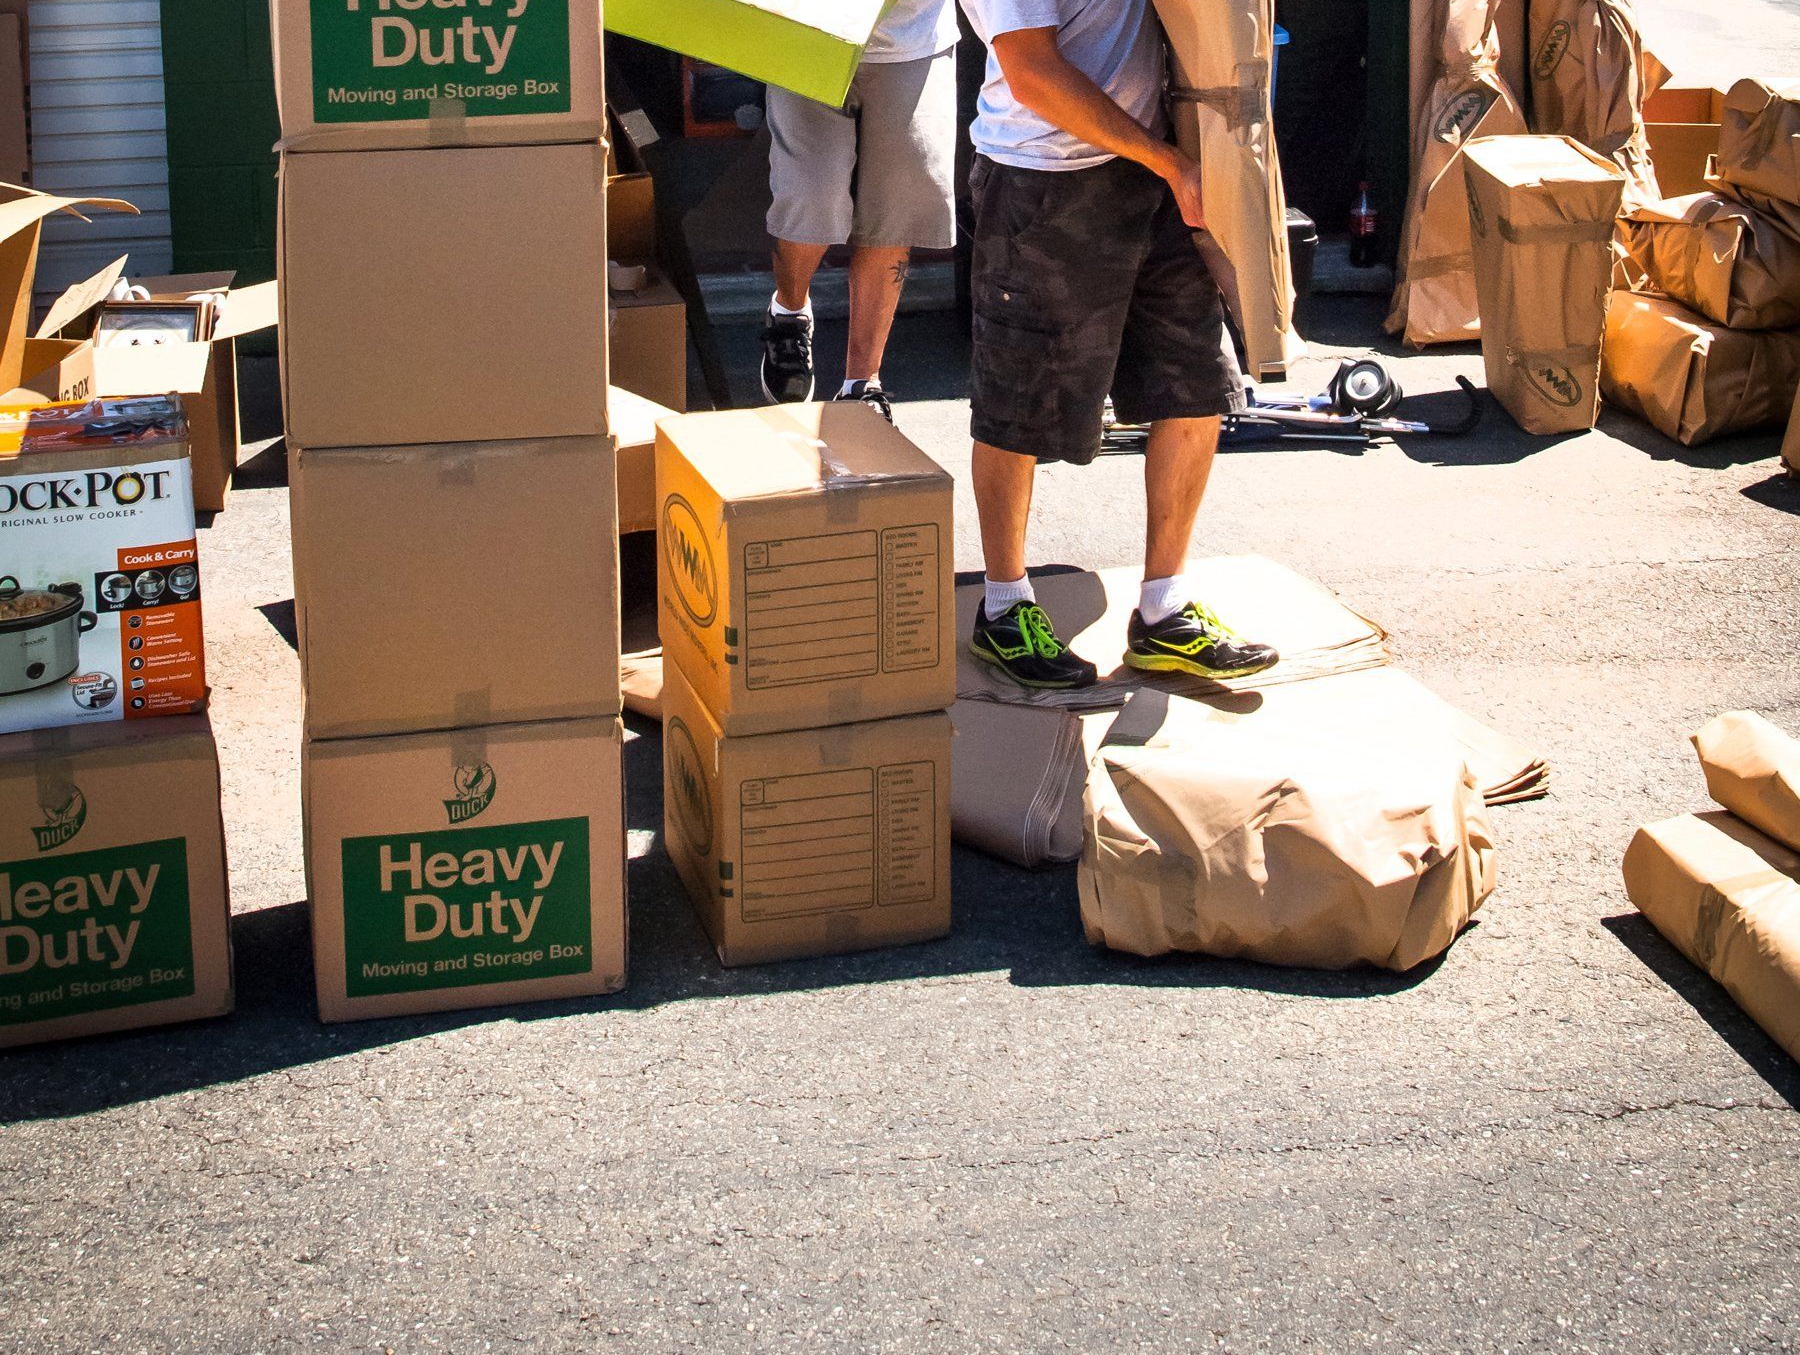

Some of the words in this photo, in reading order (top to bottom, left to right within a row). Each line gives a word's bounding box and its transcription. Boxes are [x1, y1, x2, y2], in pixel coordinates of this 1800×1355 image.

[371, 16, 517, 75] Duty
[328, 85, 396, 104] Moving
[403, 85, 438, 101] and
[444, 82, 517, 100] Storage
[524, 79, 559, 95] Box
[73, 375, 89, 400] BOX
[53, 514, 85, 523] SLOW
[89, 509, 136, 520] COOKER
[124, 553, 153, 564] Cook
[154, 552, 164, 561] &
[165, 549, 195, 559] Carry
[452, 795, 488, 820] DUCK
[40, 820, 80, 848] DUCK
[380, 841, 564, 892] Heavy
[0, 864, 161, 921] eavy
[404, 890, 544, 943] Duty
[0, 917, 141, 976] Duty
[362, 961, 427, 978] Moving
[434, 956, 467, 972] and
[473, 949, 543, 968] Storage
[550, 944, 583, 959] Box
[28, 985, 64, 1004] and
[69, 973, 143, 997] Storage
[150, 967, 185, 985] Box
